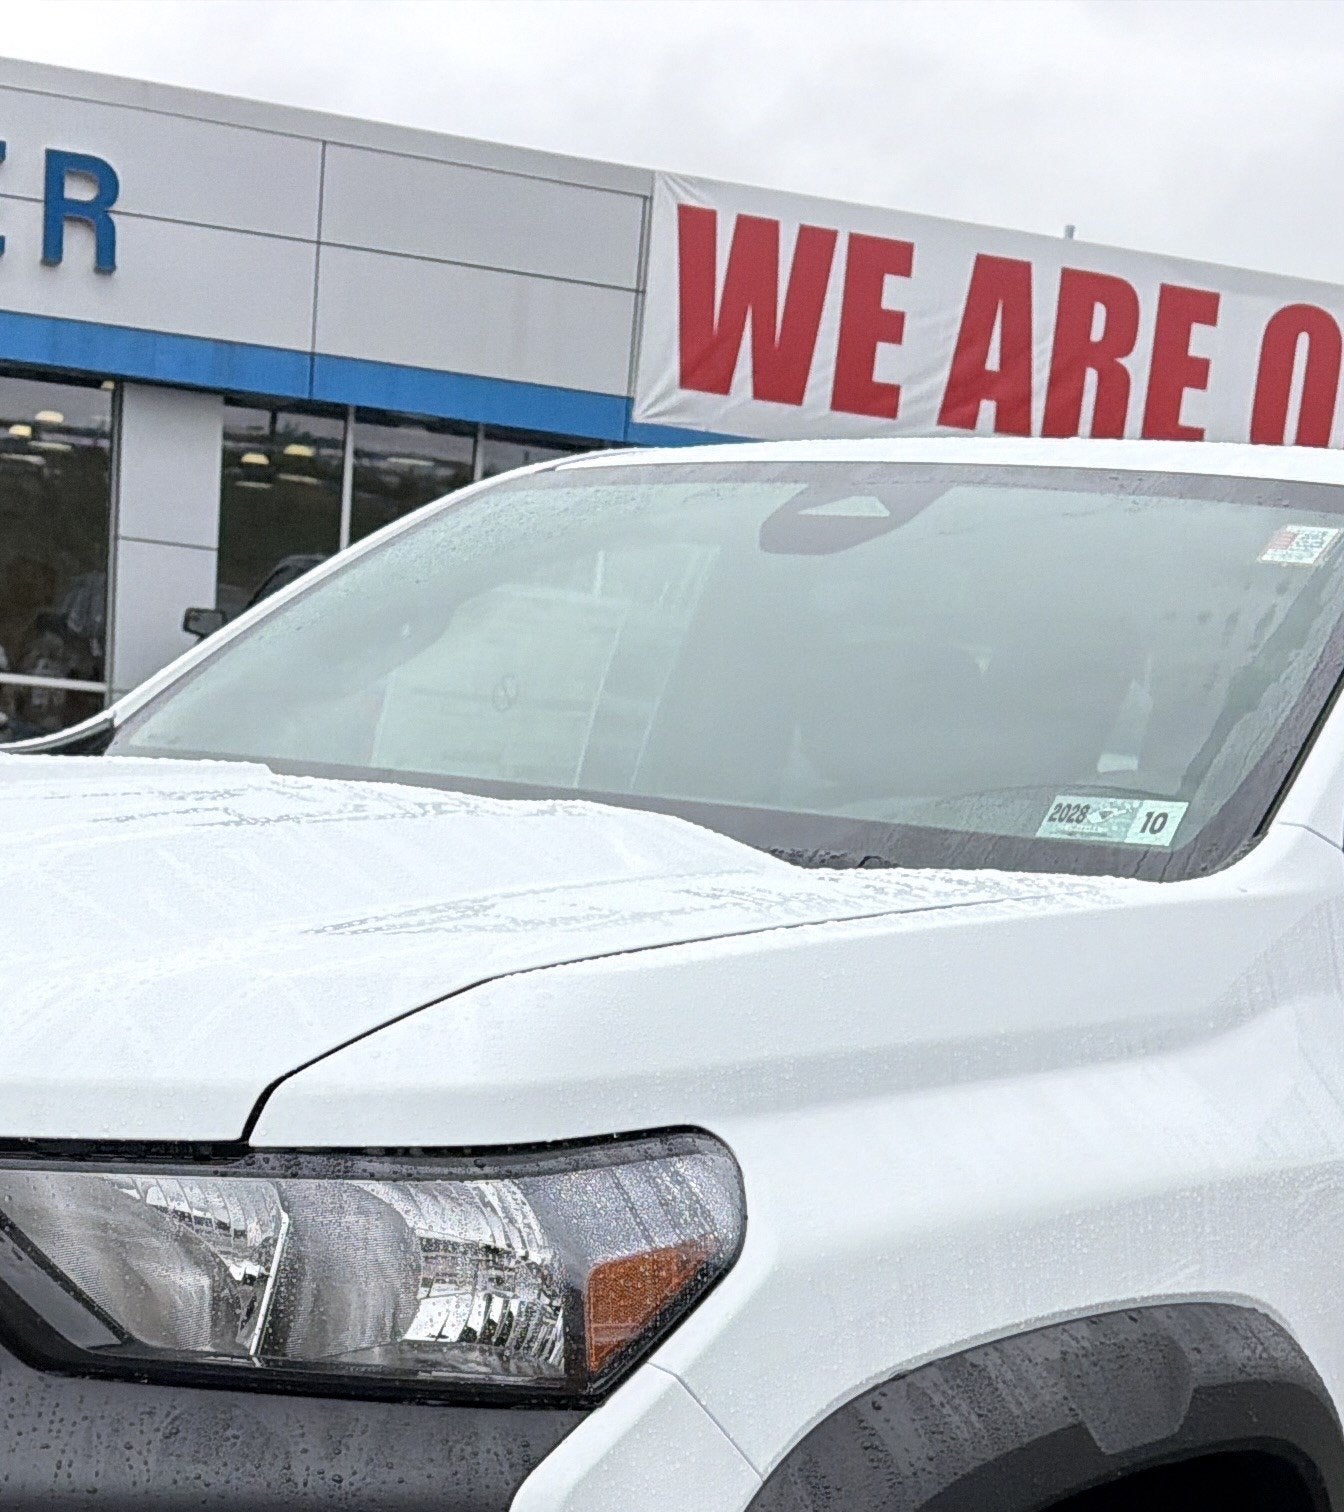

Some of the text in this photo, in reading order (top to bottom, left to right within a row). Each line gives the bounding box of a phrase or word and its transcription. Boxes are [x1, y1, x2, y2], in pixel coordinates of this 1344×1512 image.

[677, 203, 915, 420] WE
[937, 253, 1221, 441] ARE
[1139, 811, 1169, 835] 10
